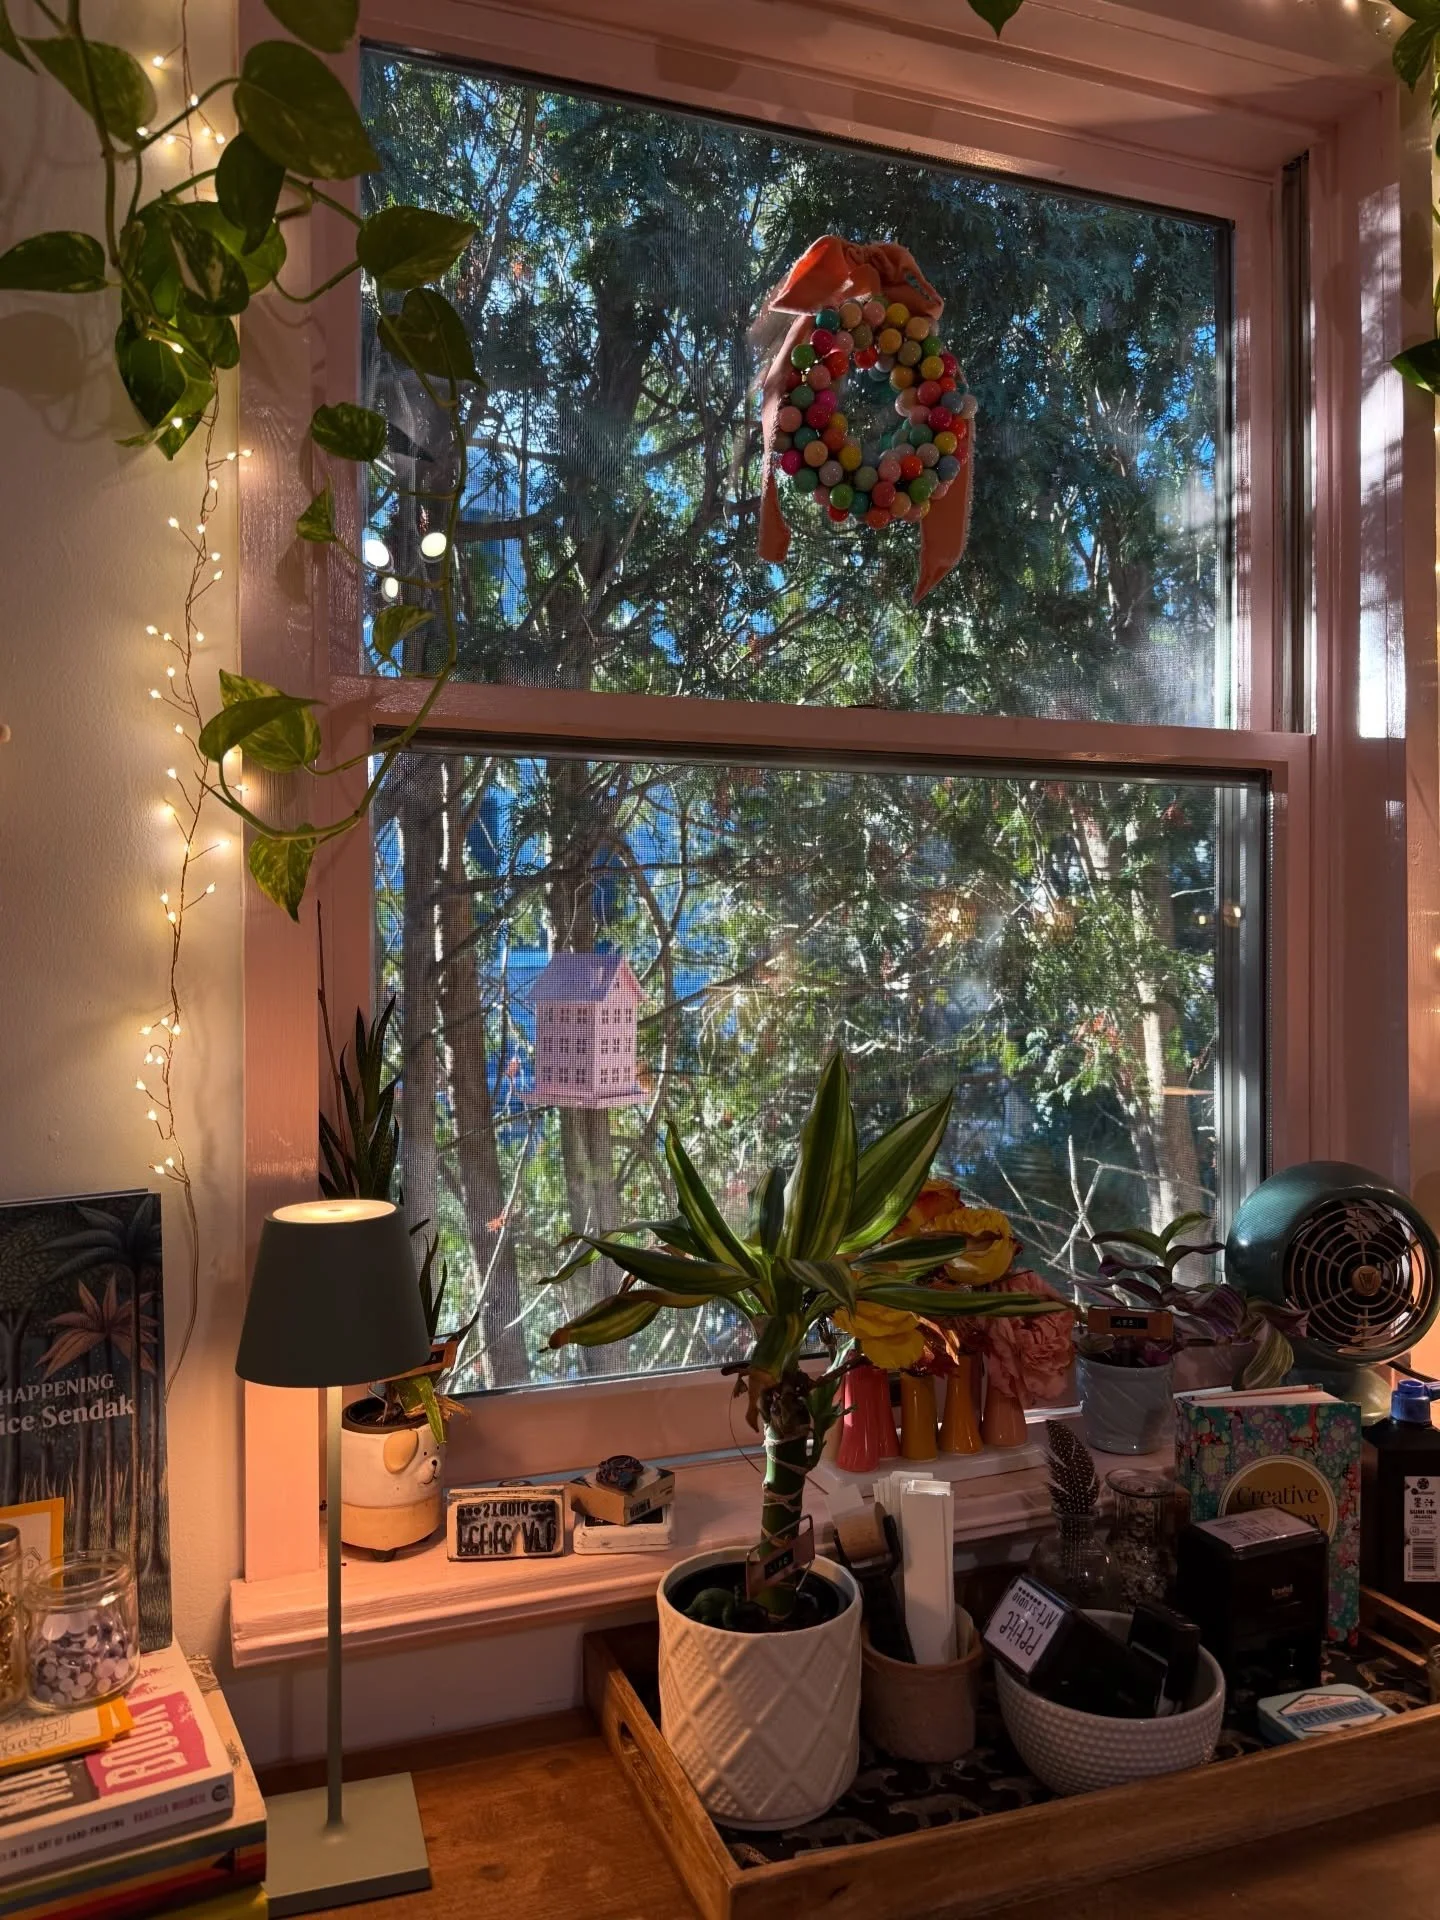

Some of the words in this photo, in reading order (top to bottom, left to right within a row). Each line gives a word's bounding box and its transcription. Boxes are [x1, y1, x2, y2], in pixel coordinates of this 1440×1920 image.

[0, 1373, 114, 1405] HAPPENING
[42, 1393, 136, 1429] Sendak
[1237, 1485, 1319, 1505] Creative
[1286, 1702, 1375, 1725] PEPPERMINTS
